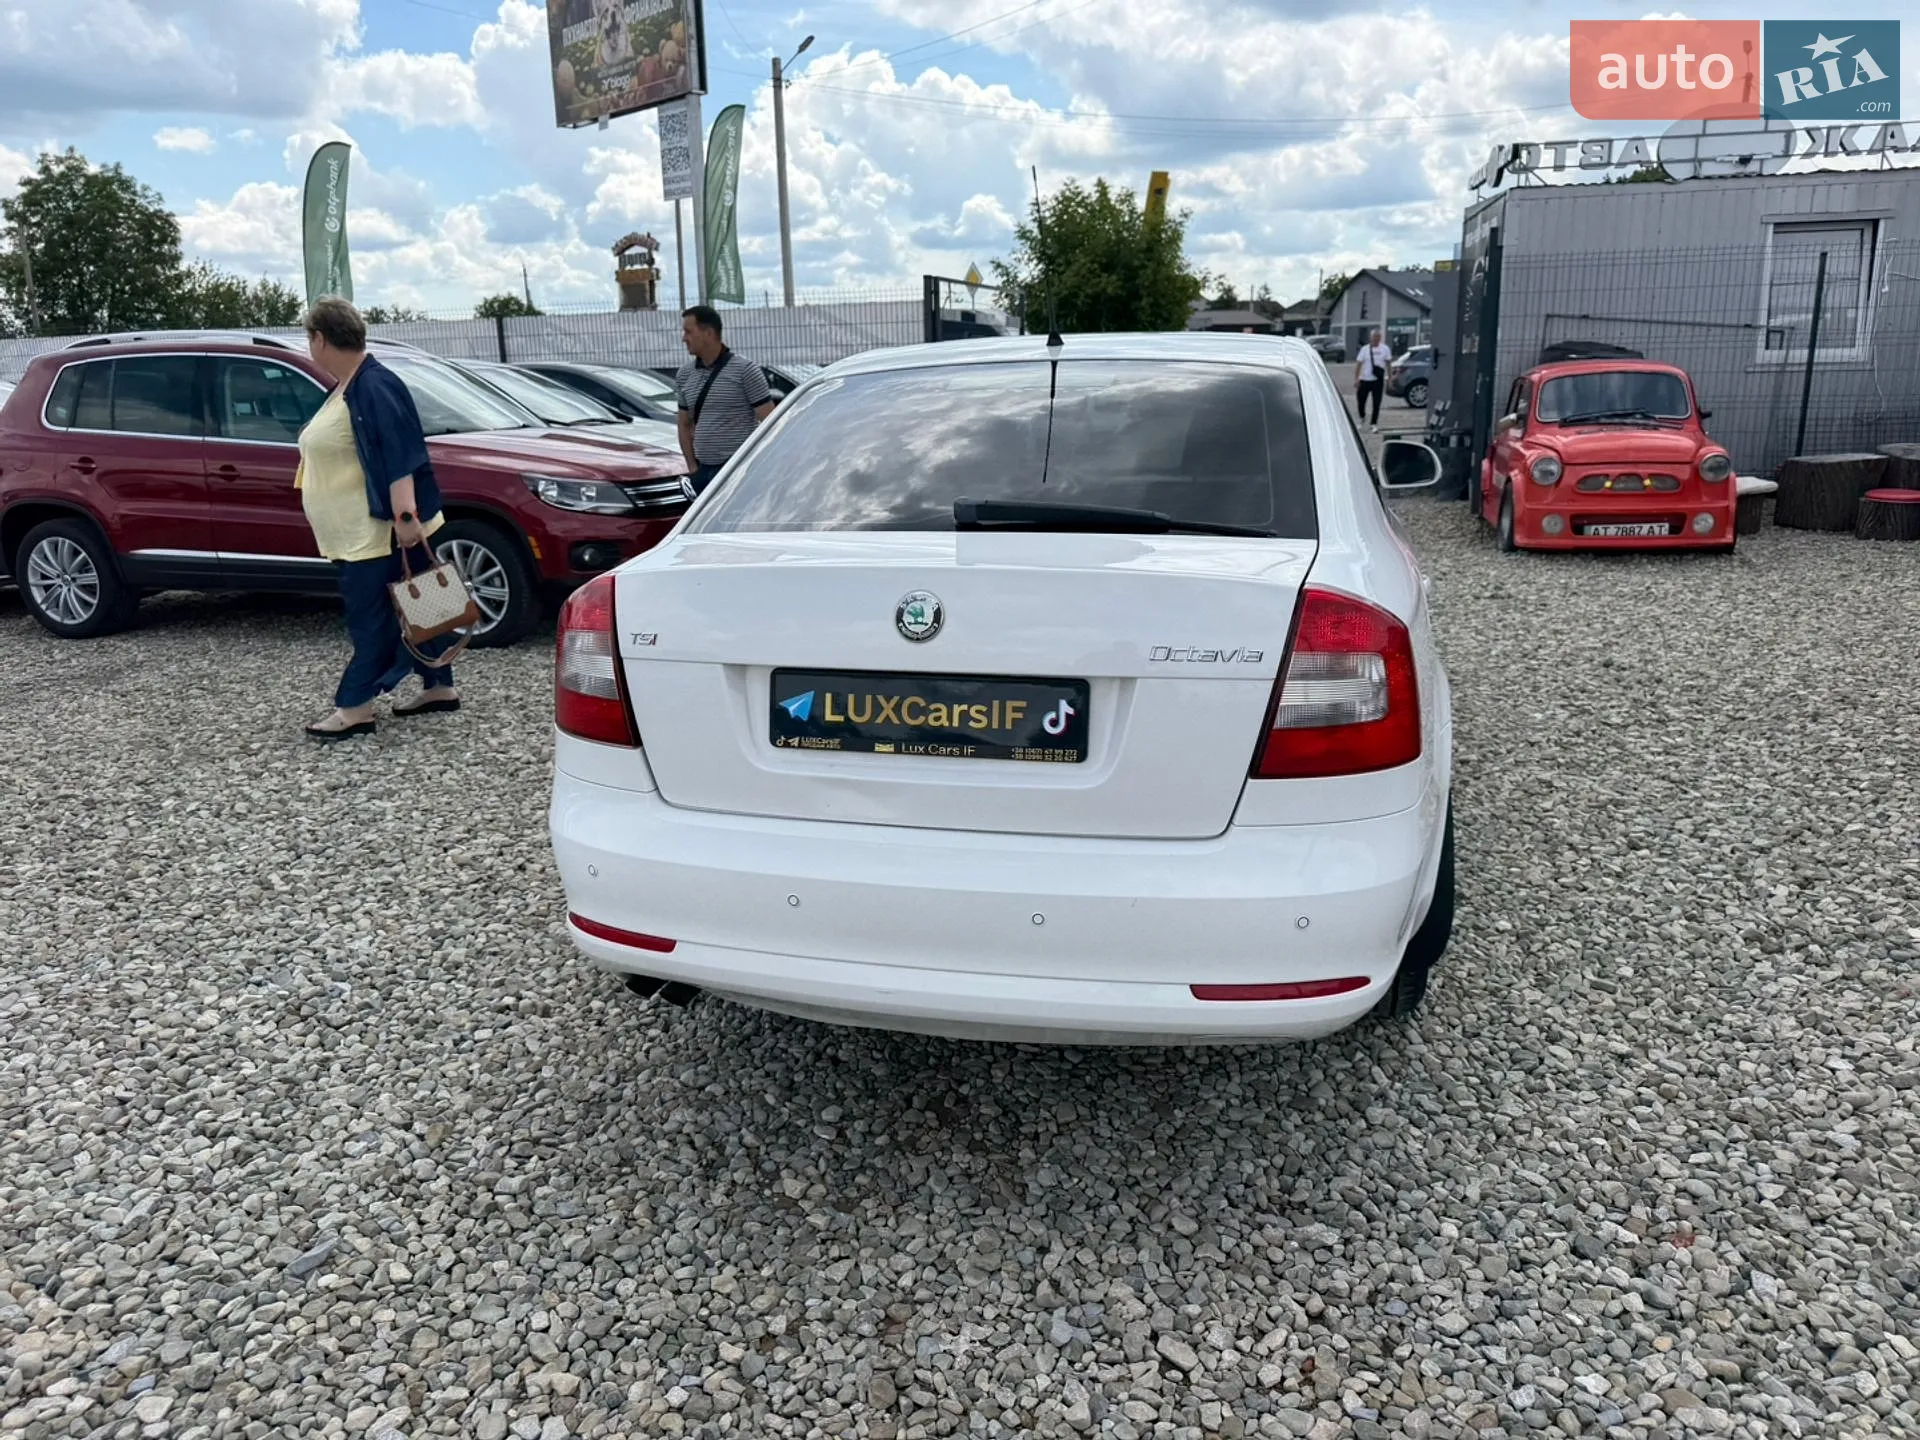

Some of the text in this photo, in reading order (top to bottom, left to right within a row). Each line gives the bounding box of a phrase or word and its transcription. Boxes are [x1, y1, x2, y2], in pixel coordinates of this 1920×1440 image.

[629, 632, 658, 646] TSI
[1149, 645, 1264, 664] Octavia
[824, 692, 1028, 730] LUXCarsIF
[901, 743, 976, 757] Lux Cars IF
